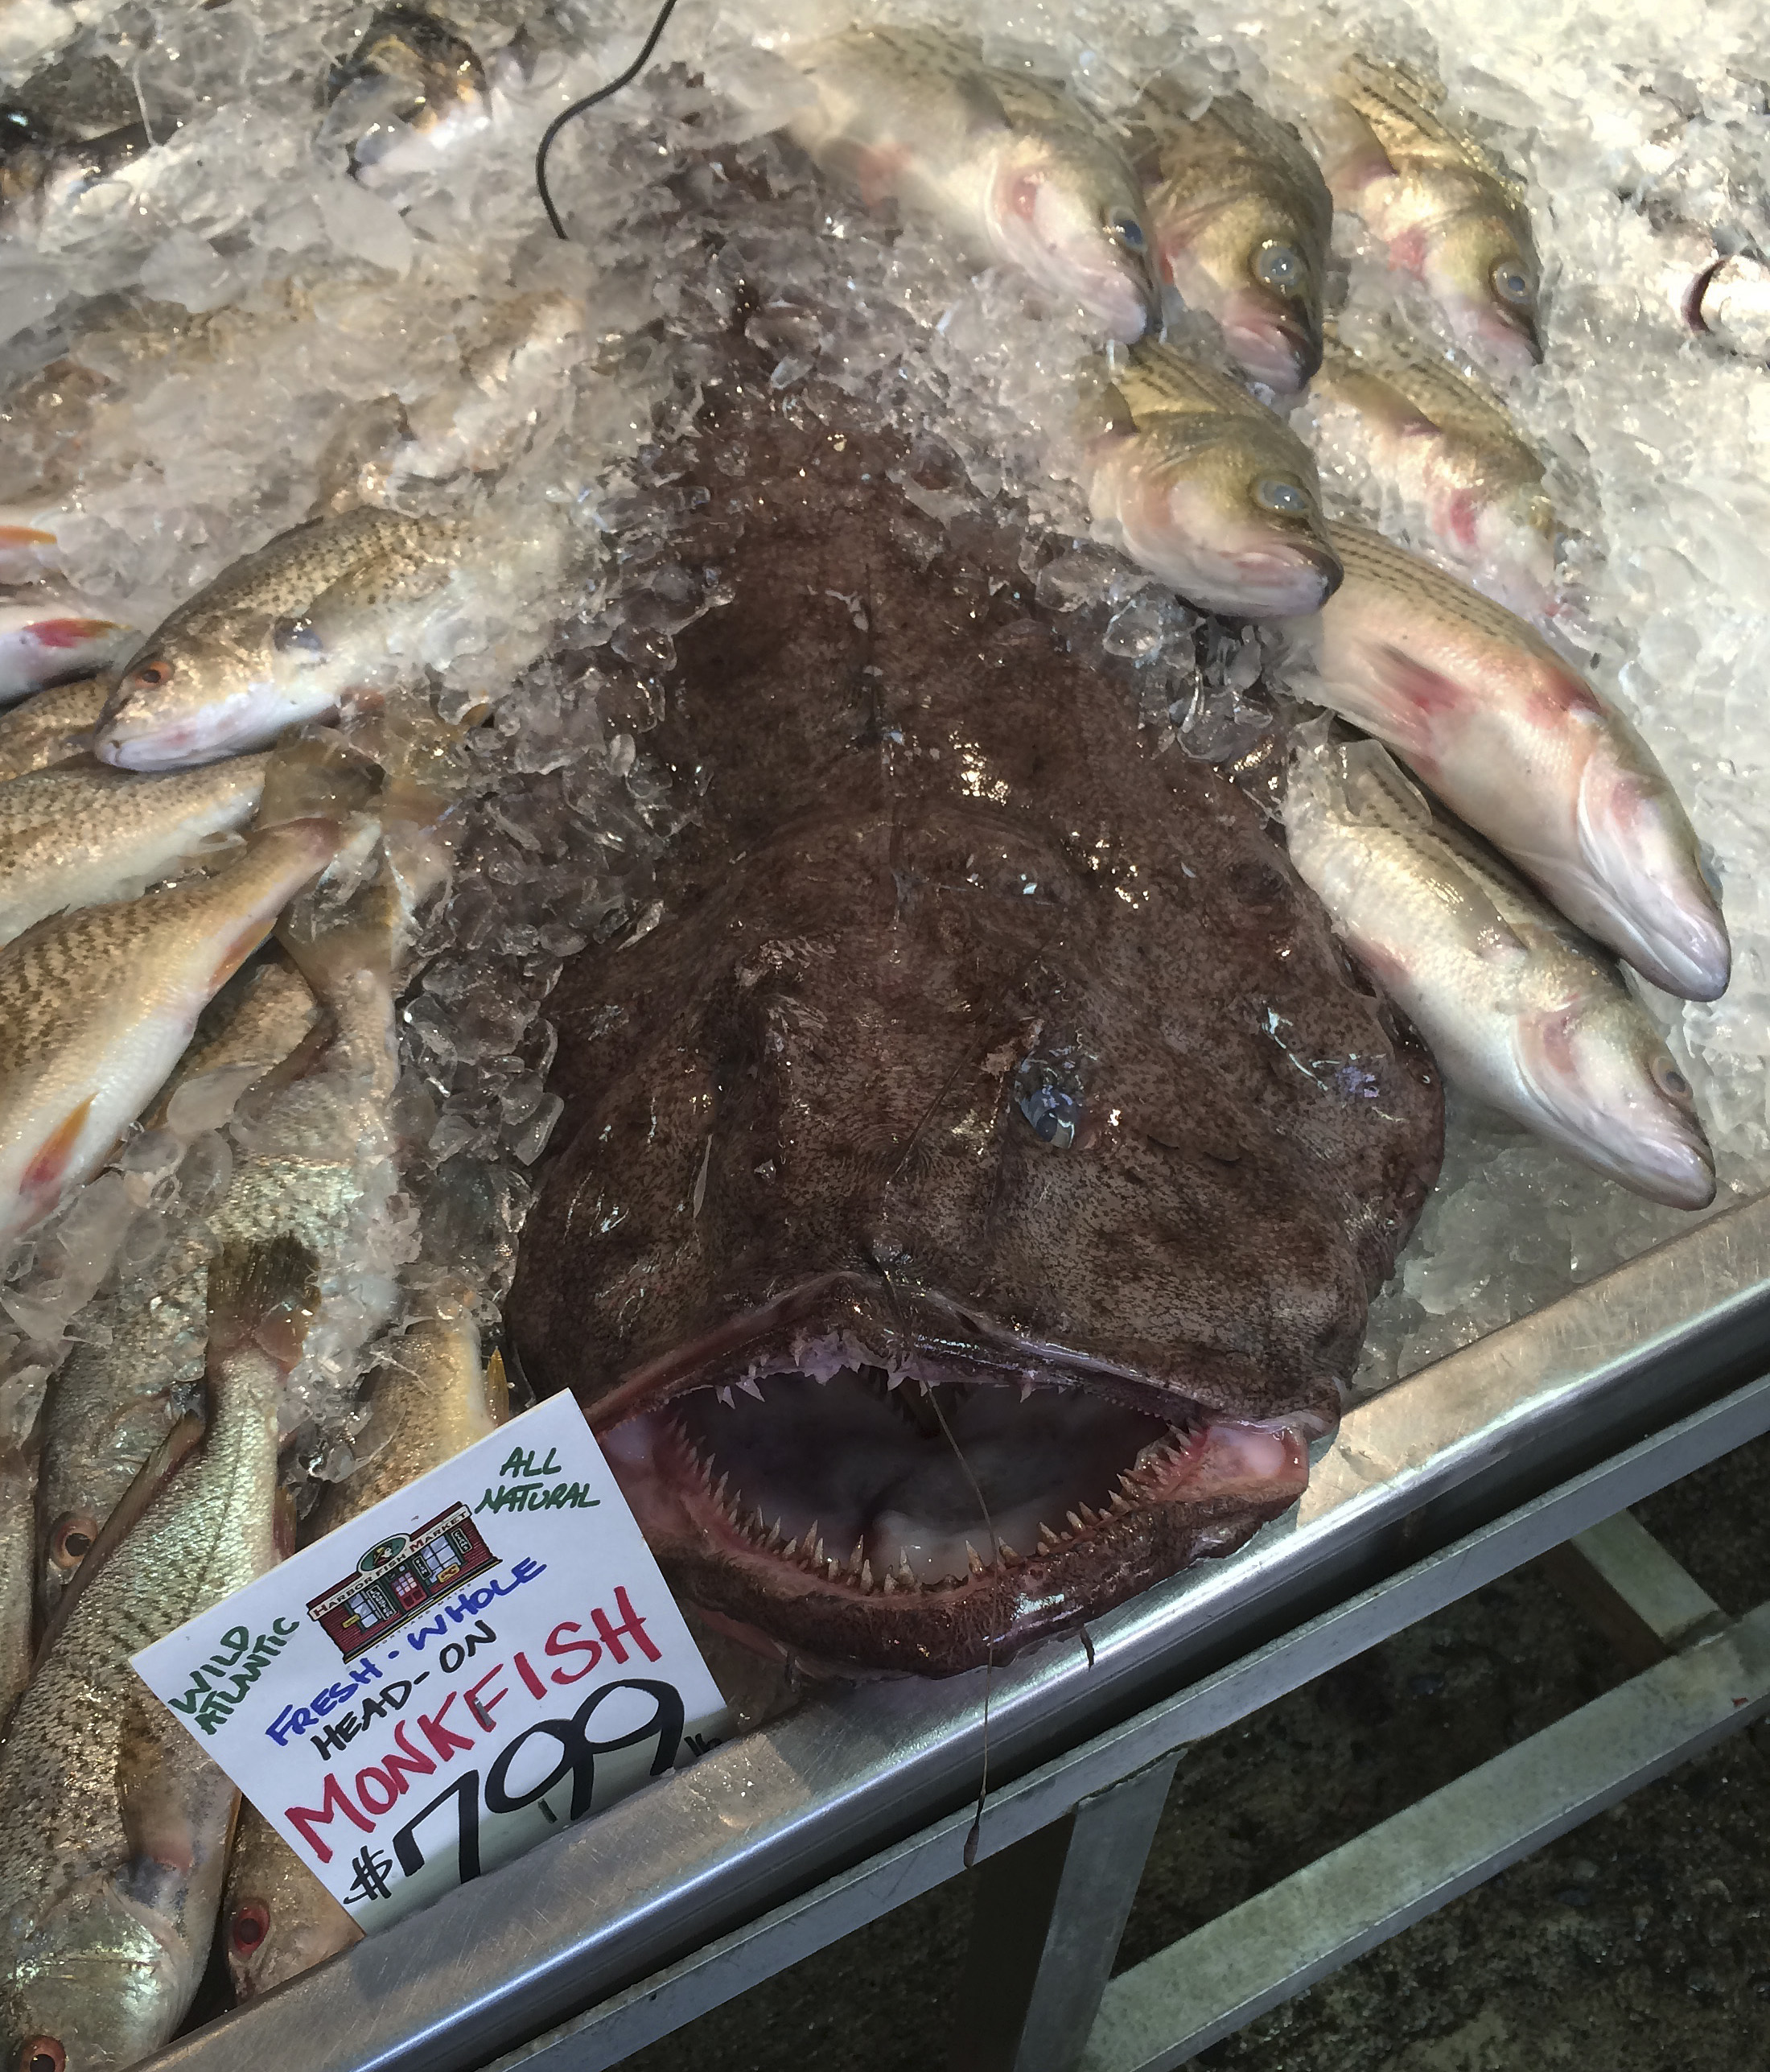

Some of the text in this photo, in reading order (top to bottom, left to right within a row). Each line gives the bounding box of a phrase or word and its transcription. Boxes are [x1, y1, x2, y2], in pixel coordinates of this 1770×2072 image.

[475, 1482, 600, 1514] NATURAL
[500, 1446, 562, 1477] ALL
[314, 1510, 467, 1618] HARBOR FISH MARKET
[168, 1625, 249, 1716] WILD
[194, 1617, 299, 1735] ATLANTIC
[266, 1556, 546, 1745] FRESH WHOLE
[285, 1586, 662, 1864] MONKFISH
